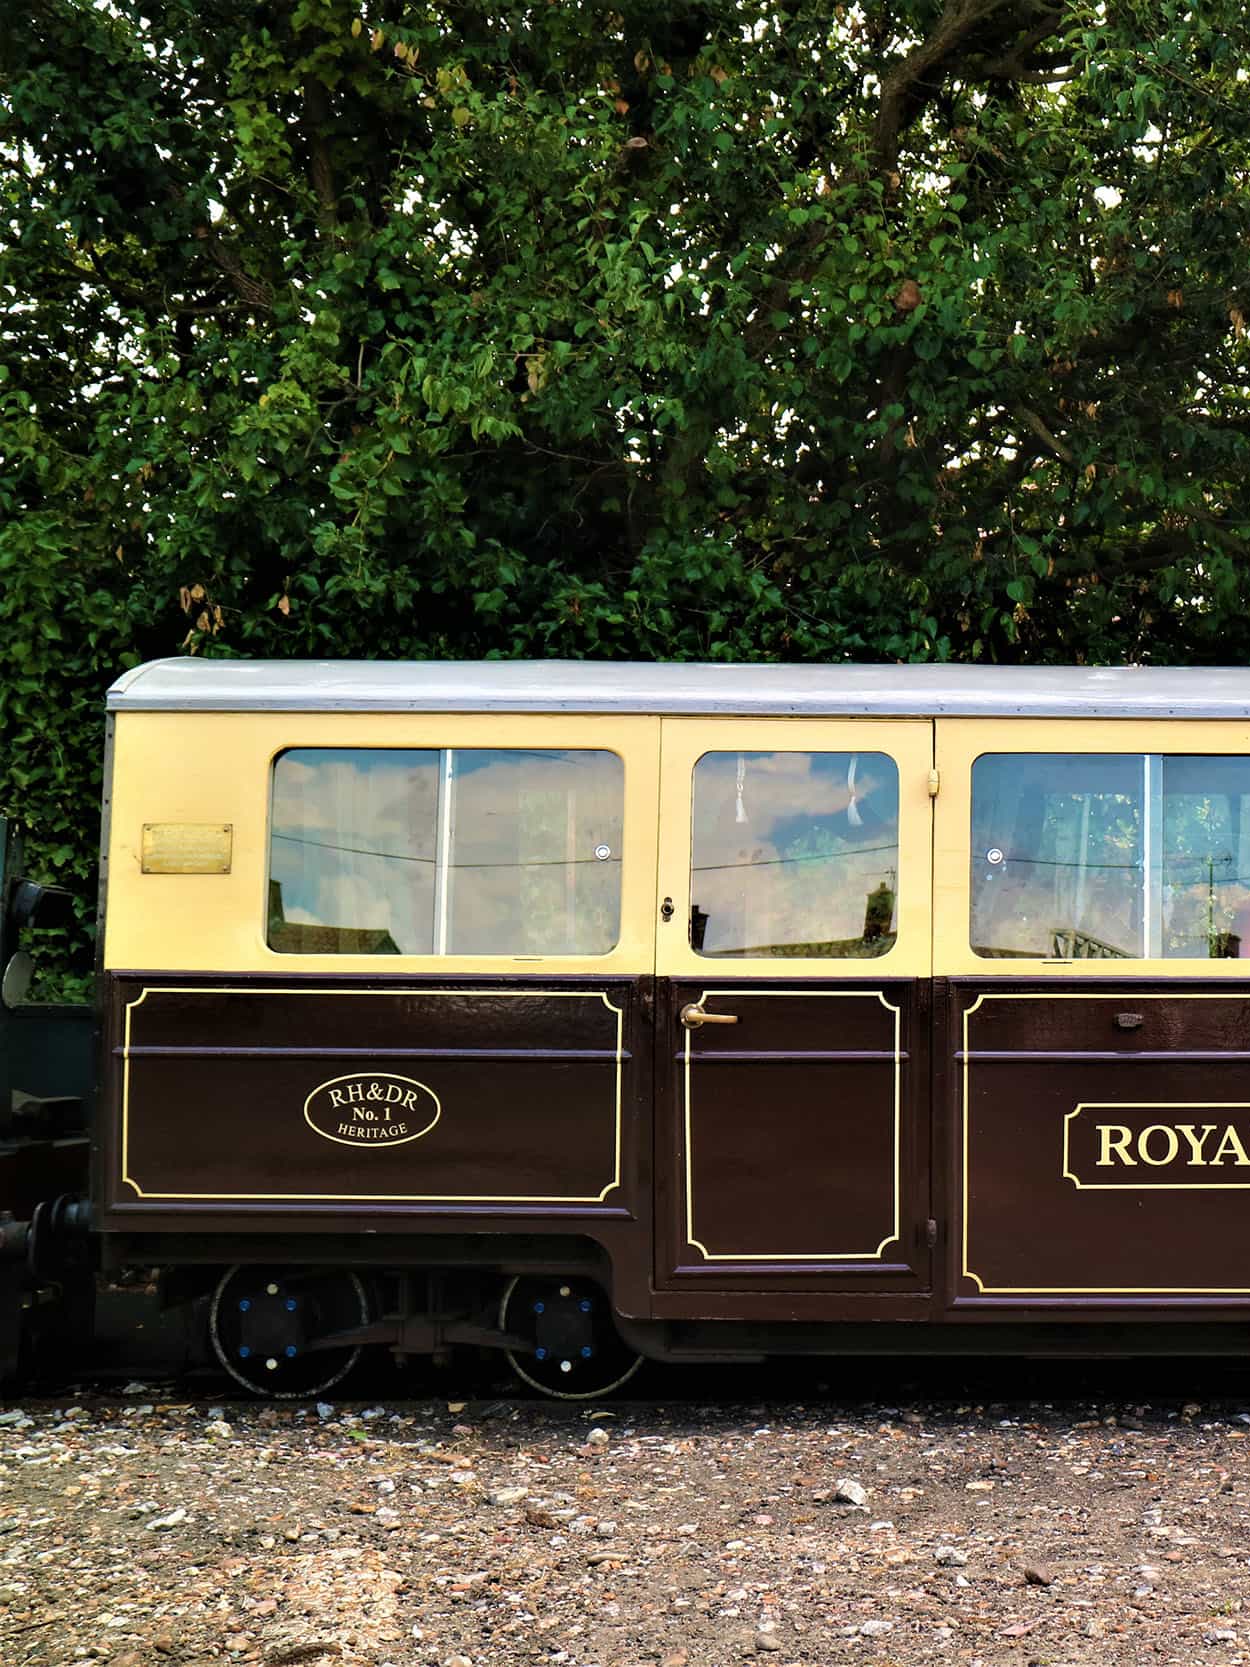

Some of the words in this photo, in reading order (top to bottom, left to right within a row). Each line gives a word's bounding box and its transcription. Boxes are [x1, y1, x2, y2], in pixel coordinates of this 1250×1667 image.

[328, 1082, 418, 1111] RH&DR
[352, 1106, 379, 1121] No.
[383, 1107, 392, 1121] 1
[337, 1122, 408, 1139] HERITAGE
